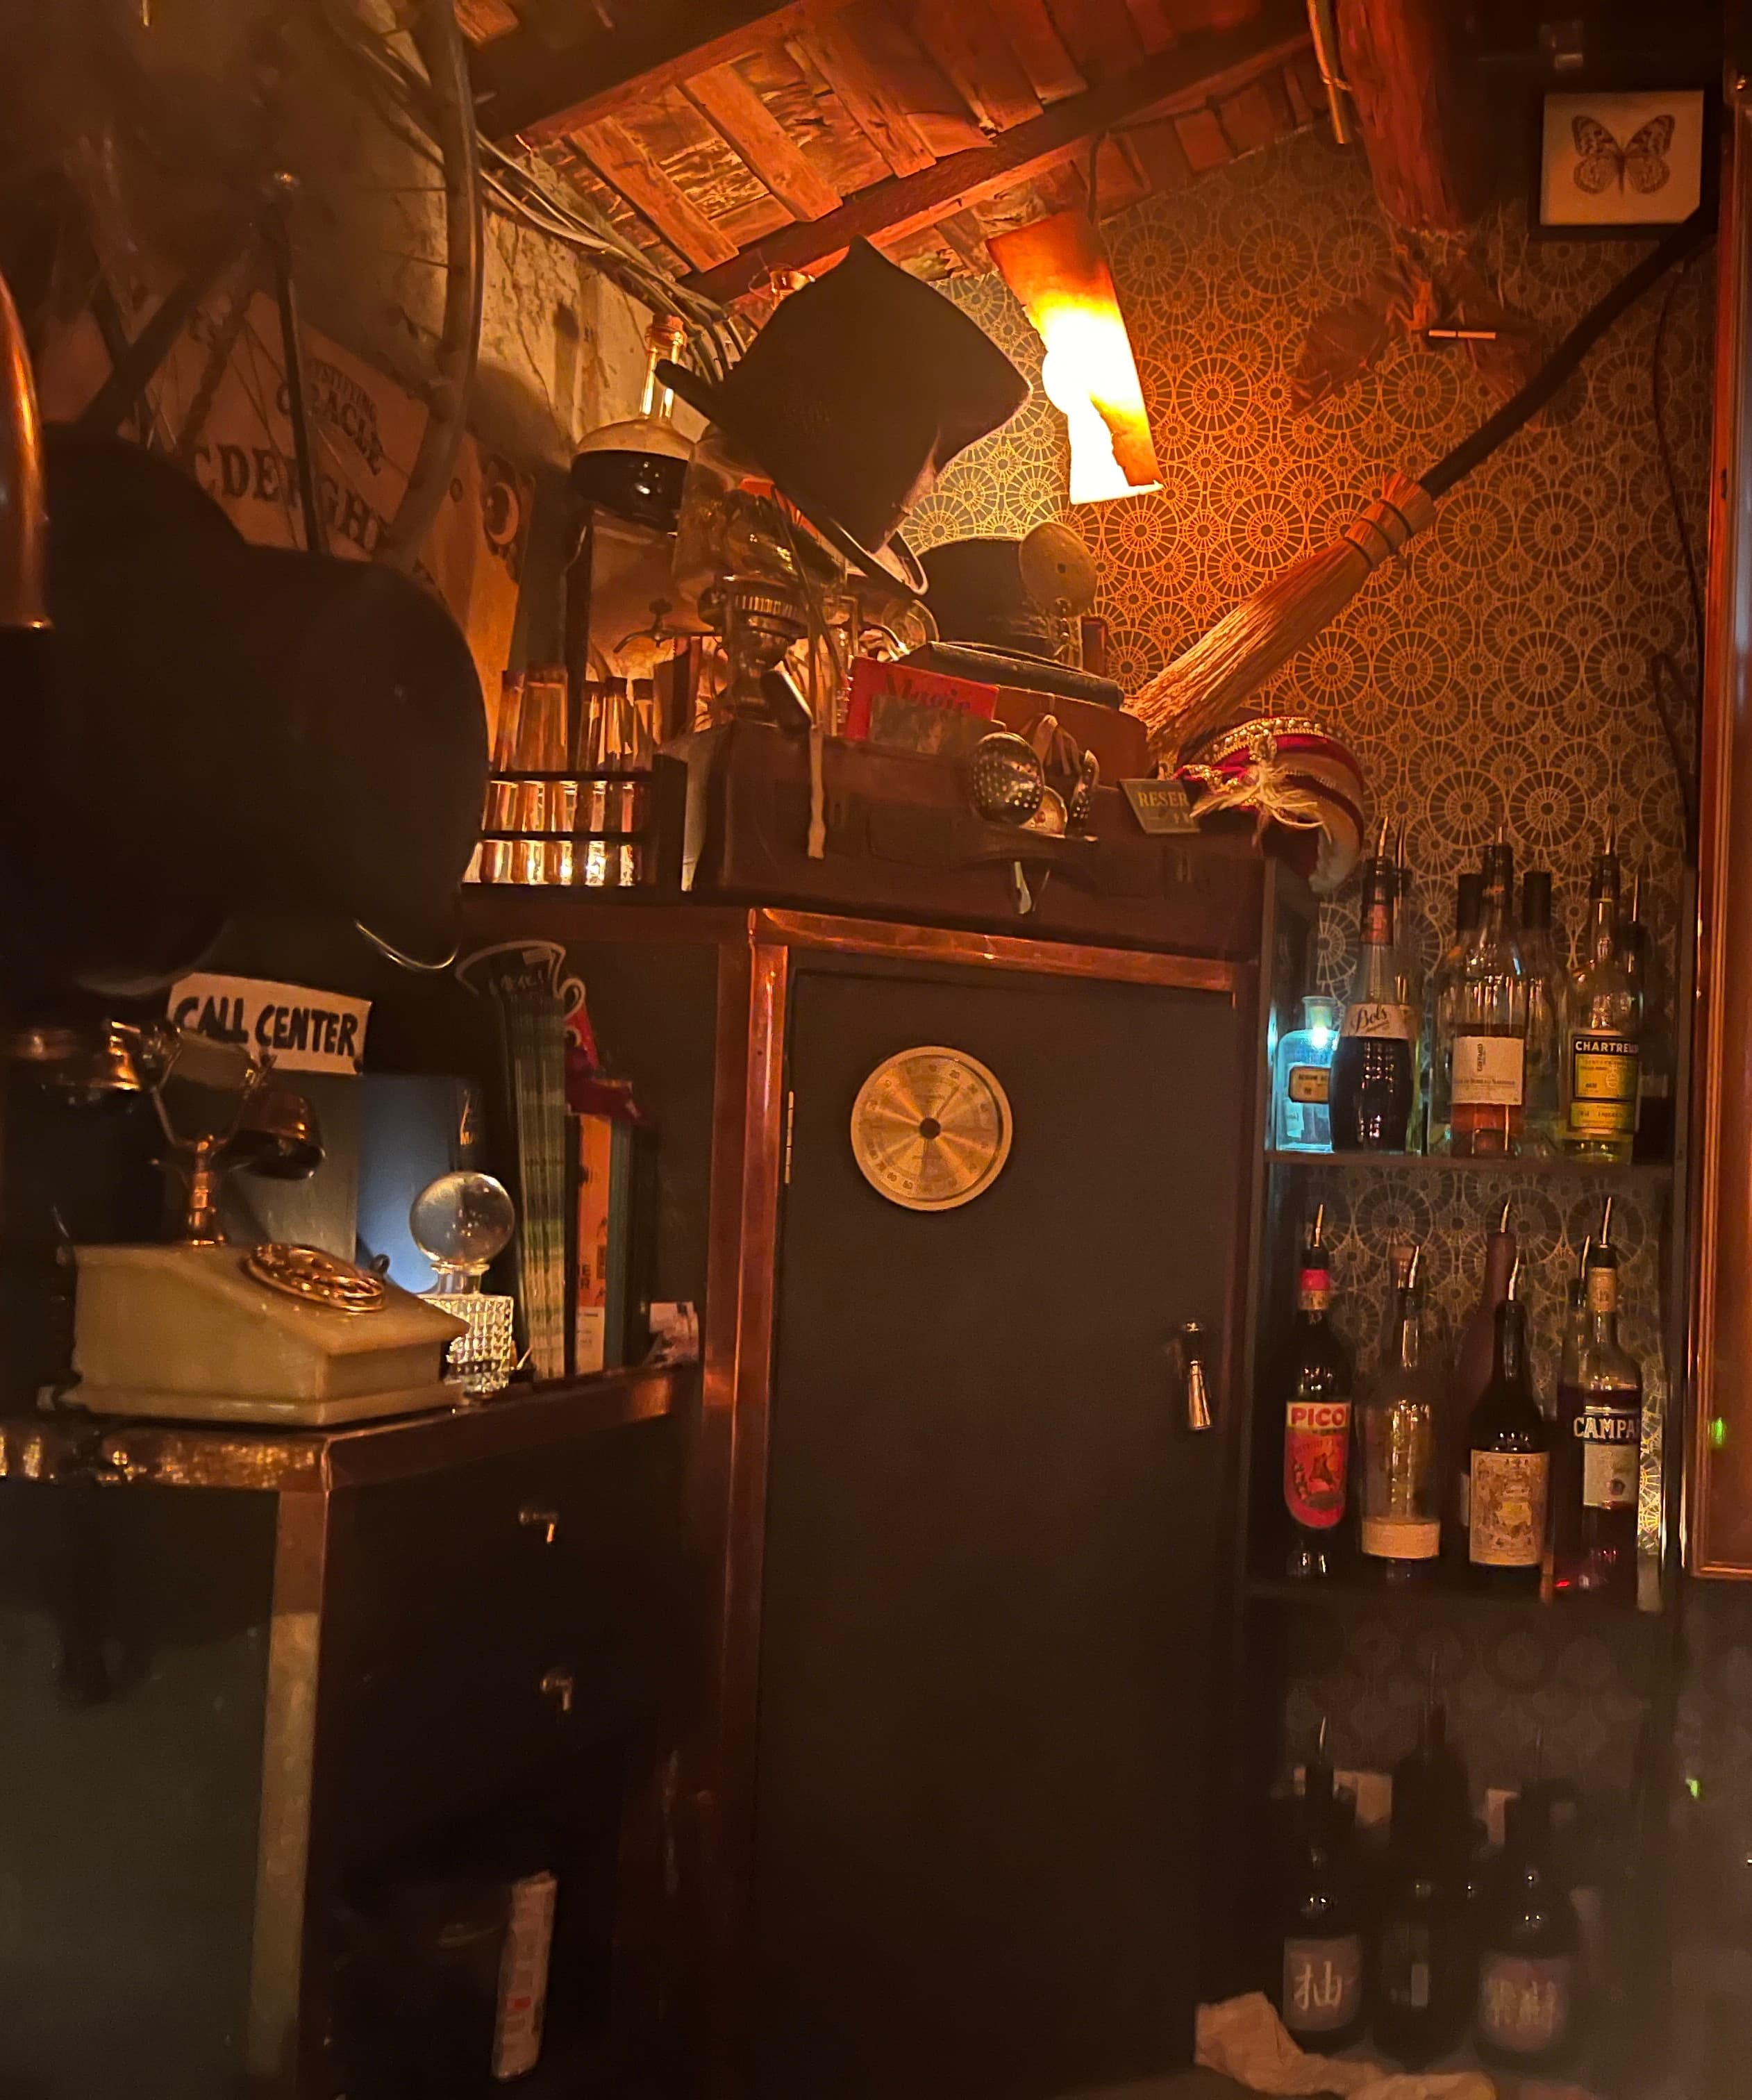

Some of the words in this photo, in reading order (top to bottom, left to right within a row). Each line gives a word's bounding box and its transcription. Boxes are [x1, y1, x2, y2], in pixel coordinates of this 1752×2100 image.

[174, 996, 249, 1043] CALL
[255, 1004, 358, 1056] CENTER
[1350, 1003, 1387, 1033] Bols
